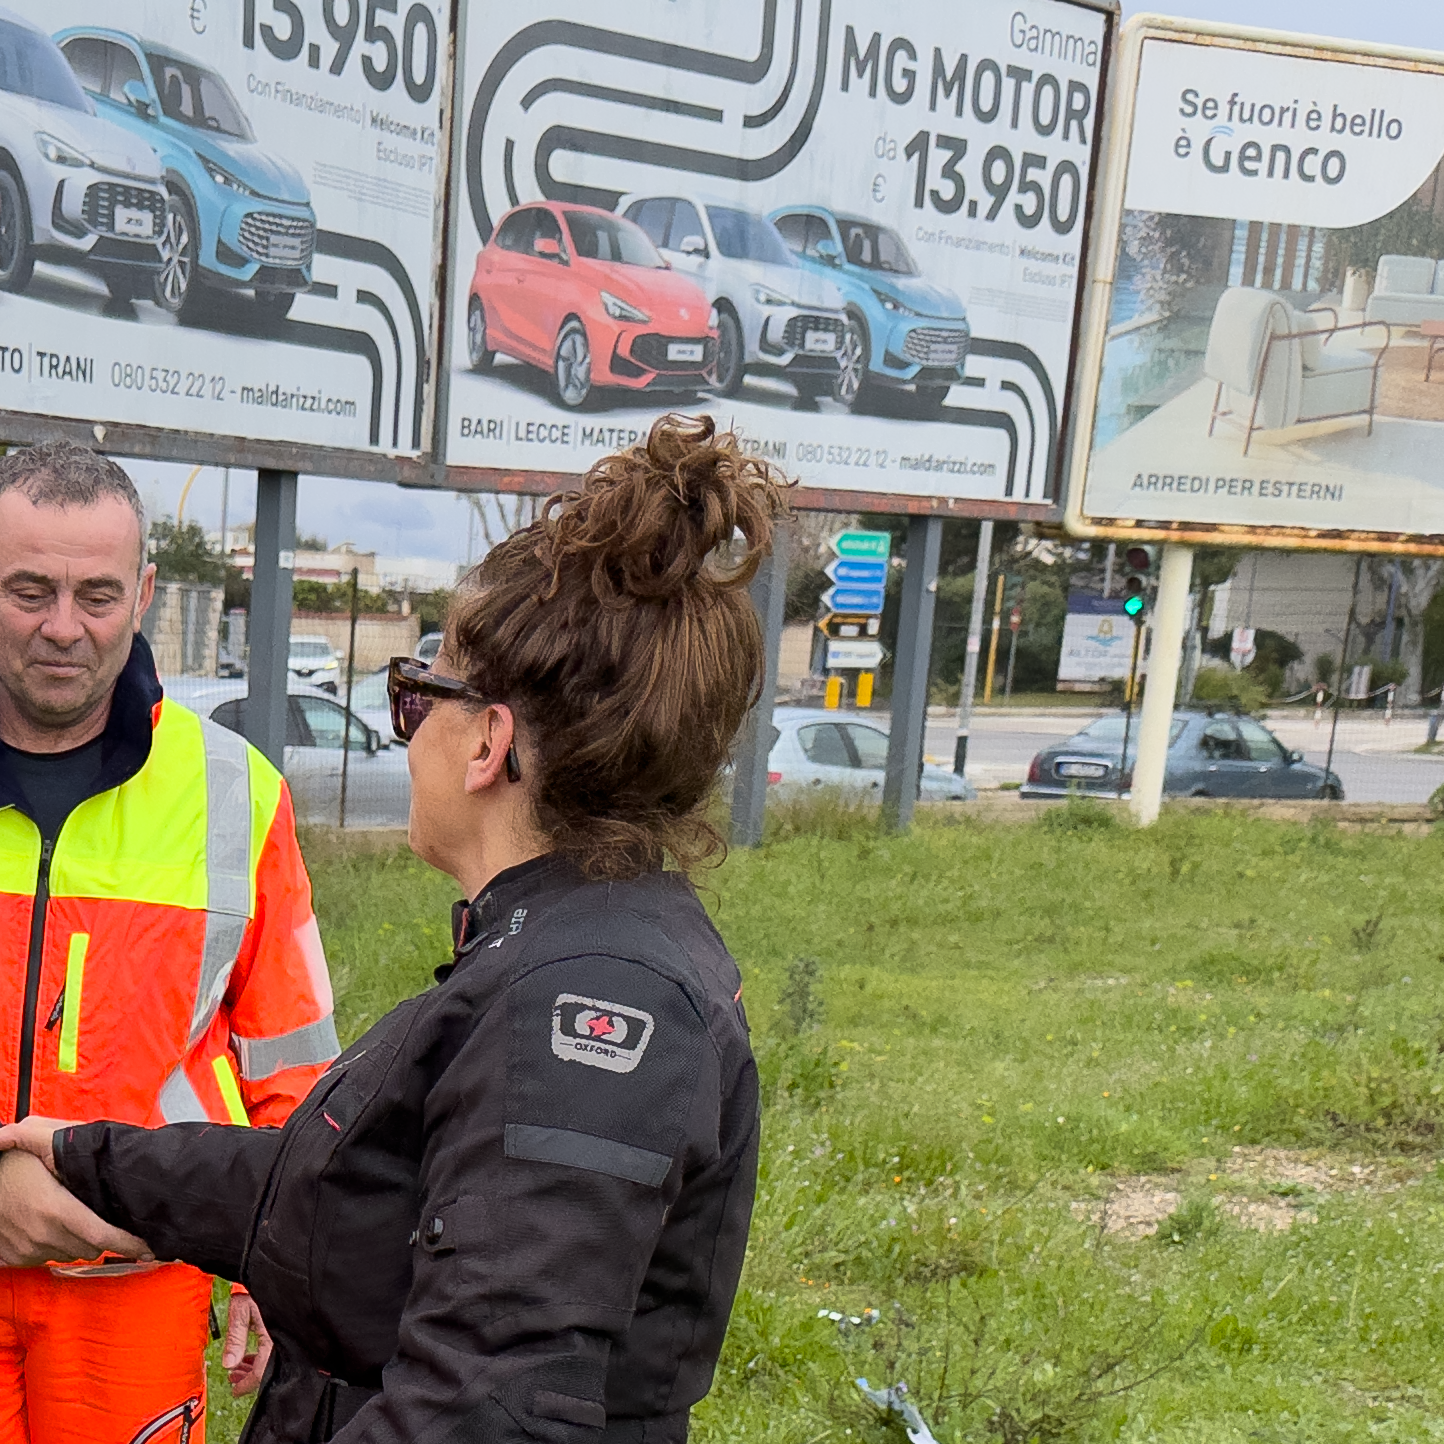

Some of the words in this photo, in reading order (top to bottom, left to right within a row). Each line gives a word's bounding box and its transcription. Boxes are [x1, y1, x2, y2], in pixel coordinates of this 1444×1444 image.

[1011, 11, 1098, 67] Gamma
[247, 74, 271, 98] Con
[273, 81, 362, 125] Finanziamento
[369, 110, 418, 141] Welcome
[420, 125, 436, 147] Kit
[840, 24, 917, 106] MG
[929, 46, 1091, 145] MOTOR
[1179, 88, 1218, 120] Se
[1227, 93, 1298, 129] fuori
[1306, 101, 1322, 131] è
[1330, 104, 1403, 141] bello
[376, 141, 416, 169] Escluso
[874, 132, 897, 161] da
[905, 130, 1080, 235] 13.950
[1174, 128, 1191, 158] è
[1202, 126, 1346, 185] Genco
[36, 351, 93, 384] TRANI
[111, 362, 144, 391] 080
[150, 367, 180, 395] 532
[185, 372, 207, 398] 22
[210, 375, 224, 400] 12
[240, 384, 356, 418] maldarizzi.com
[461, 417, 503, 440] BARI
[515, 421, 570, 445] LECCE
[581, 426, 646, 448] MATER
[900, 453, 996, 476] maldarizzi.com
[1131, 473, 1209, 495] ARREDI
[1214, 477, 1253, 496] PER
[1259, 479, 1343, 502] ESTERNI
[575, 1043, 617, 1058] OXFORD
